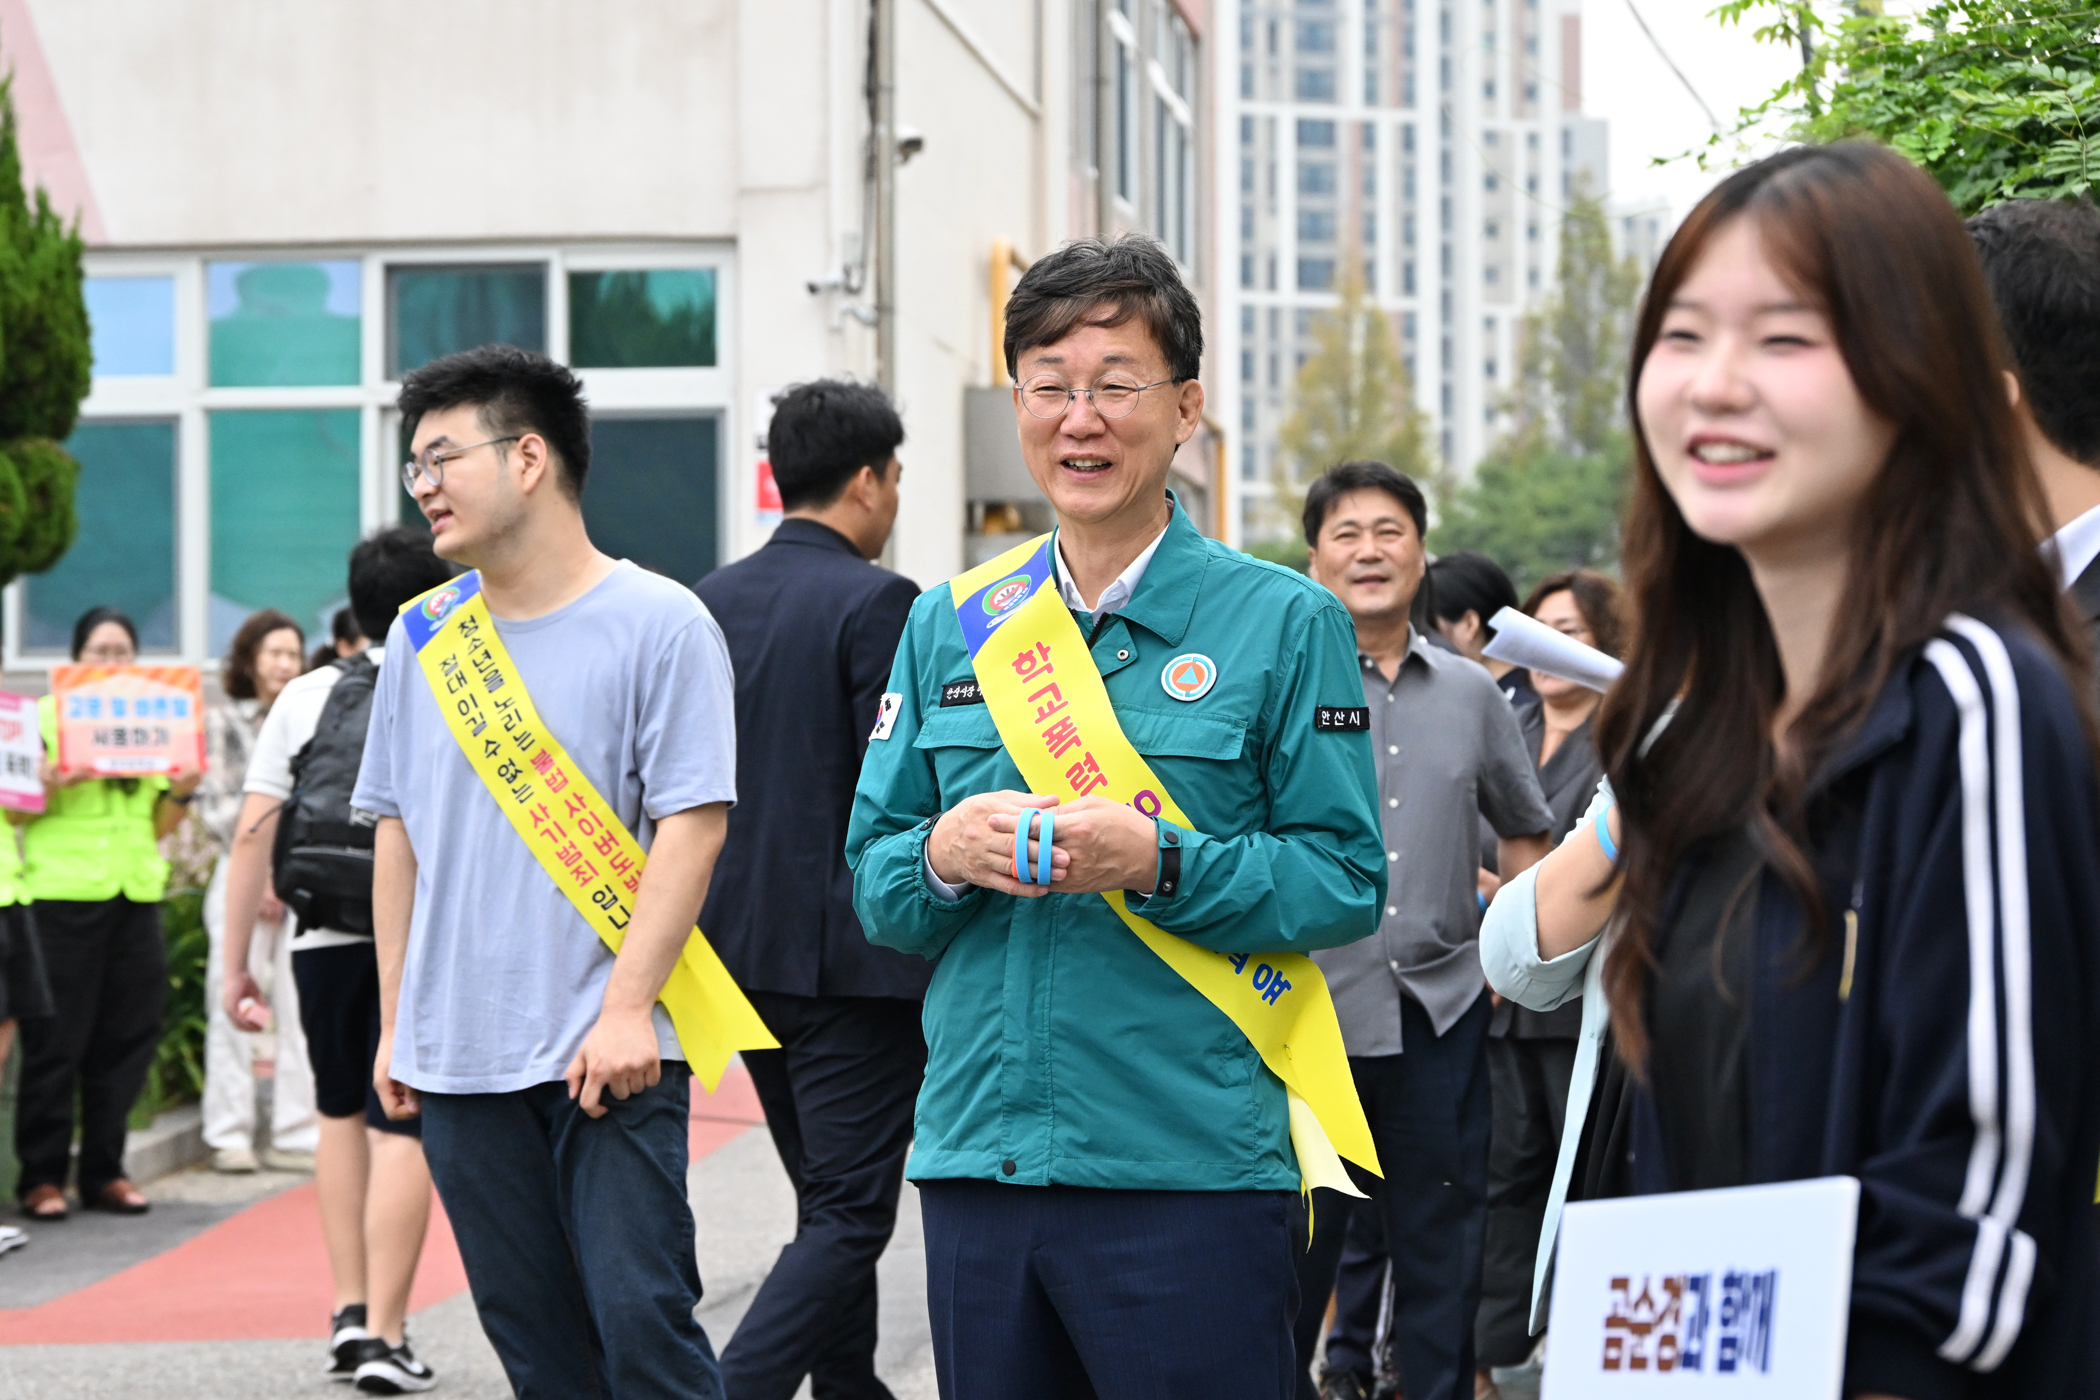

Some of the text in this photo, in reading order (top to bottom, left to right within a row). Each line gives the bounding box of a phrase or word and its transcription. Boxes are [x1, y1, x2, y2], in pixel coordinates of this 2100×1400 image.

[439, 653, 467, 694] 절대
[458, 693, 487, 737] 이길
[484, 739, 502, 760] 수
[498, 757, 534, 804] 없는
[528, 802, 600, 888] 사기범죄
[458, 614, 505, 694] 청소년을
[494, 697, 535, 752] 노리는
[530, 747, 569, 795] 불법
[1011, 641, 1109, 798] 학교폭력
[1321, 710, 1360, 726] 안산시
[1603, 1269, 1777, 1373] 곰순경과 함께
